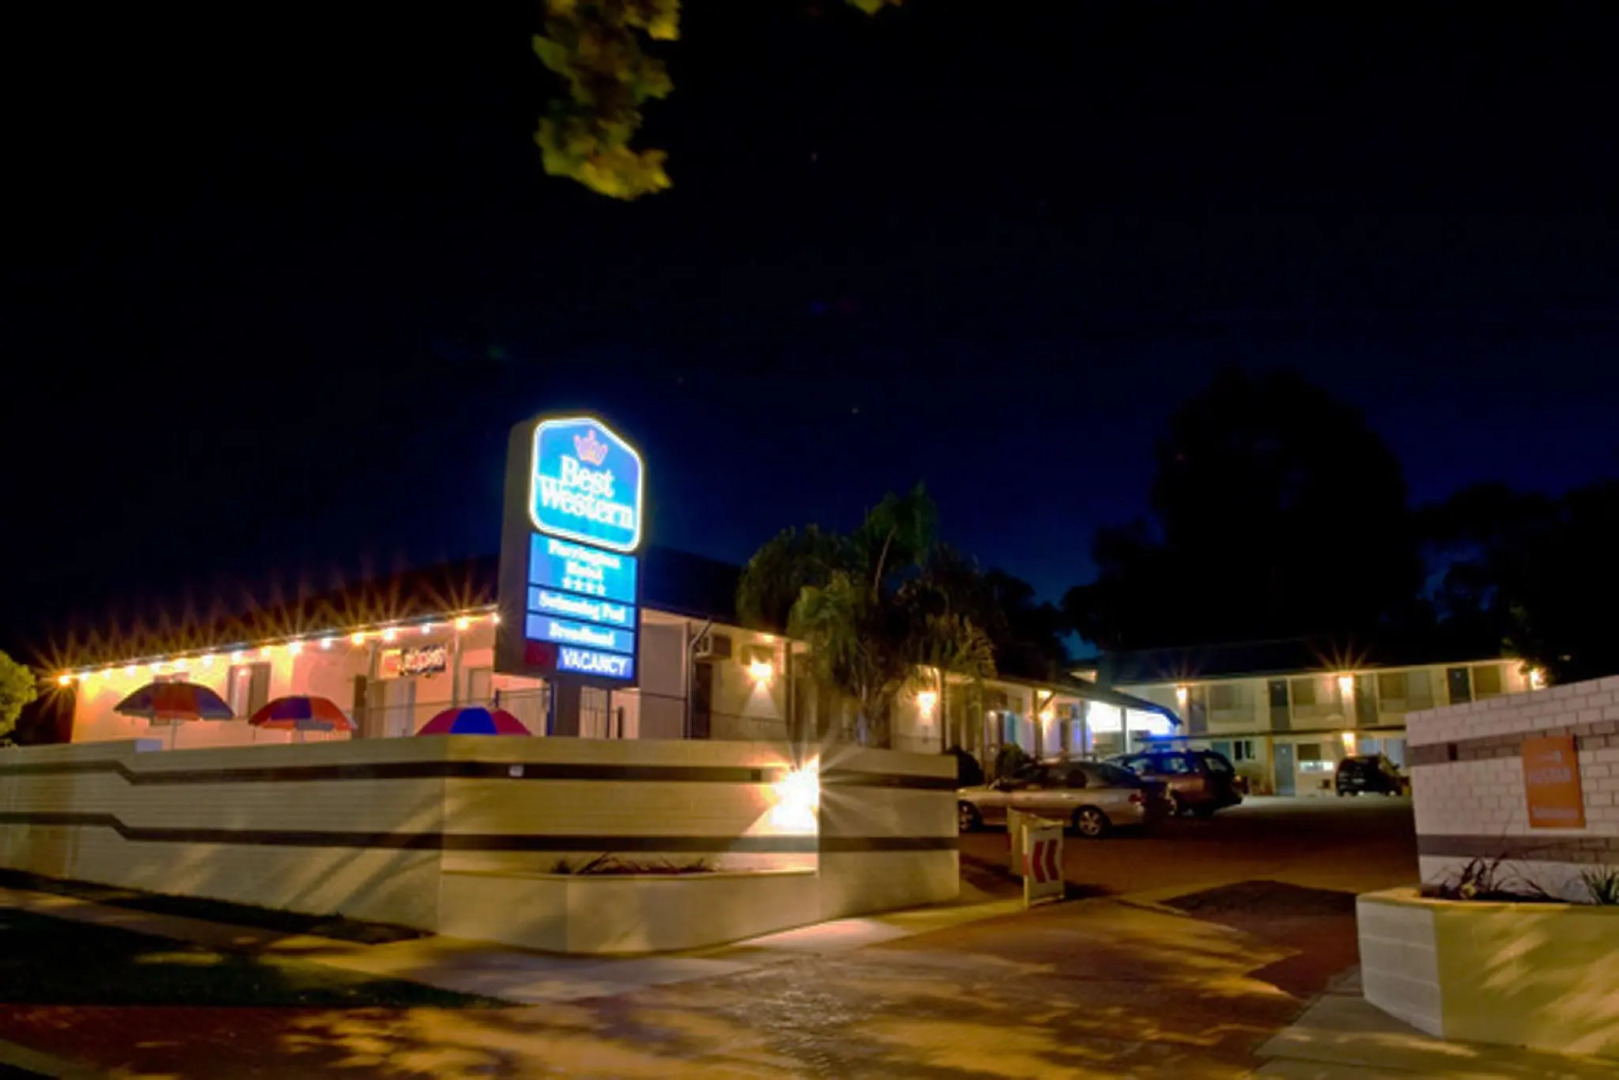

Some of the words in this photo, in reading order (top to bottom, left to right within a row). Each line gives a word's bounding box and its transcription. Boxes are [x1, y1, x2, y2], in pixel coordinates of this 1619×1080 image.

[561, 454, 615, 498] Best
[537, 474, 634, 529] Western
[561, 647, 628, 676] VACANCY
